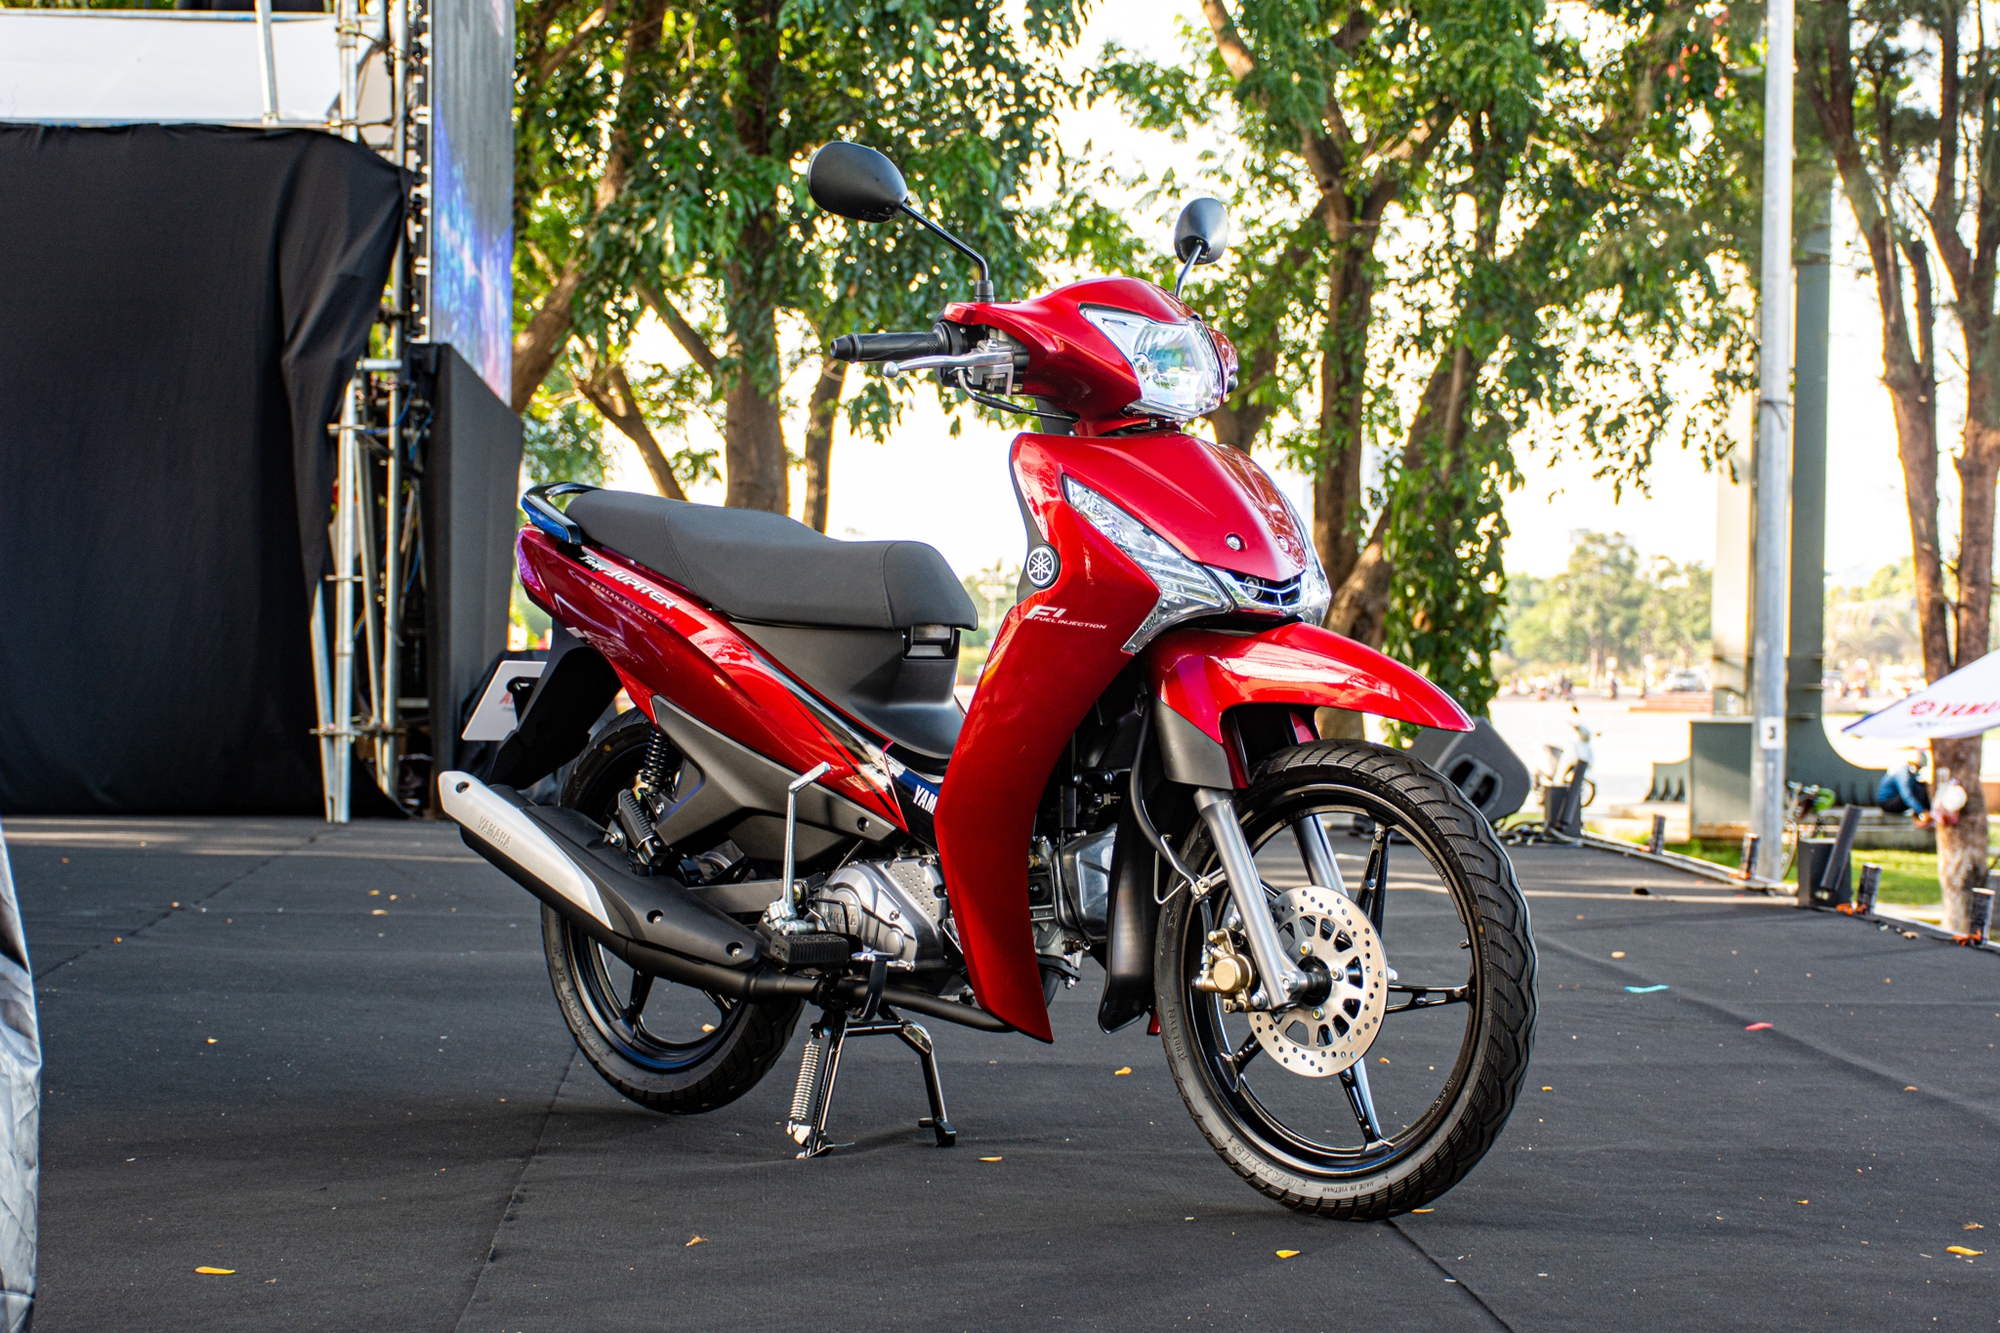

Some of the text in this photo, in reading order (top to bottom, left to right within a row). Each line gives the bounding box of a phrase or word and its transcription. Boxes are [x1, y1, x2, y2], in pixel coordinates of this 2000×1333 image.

[591, 581, 657, 622] MODERN ELEGANT
[603, 570, 677, 610] JUPITER
[1033, 615, 1107, 630] FUEL INJECTION
[1767, 725, 1777, 740] 3
[477, 815, 511, 849] YAMAHA
[1231, 1143, 1298, 1189] MAXXIS
[1358, 1181, 1374, 1190] MADE
